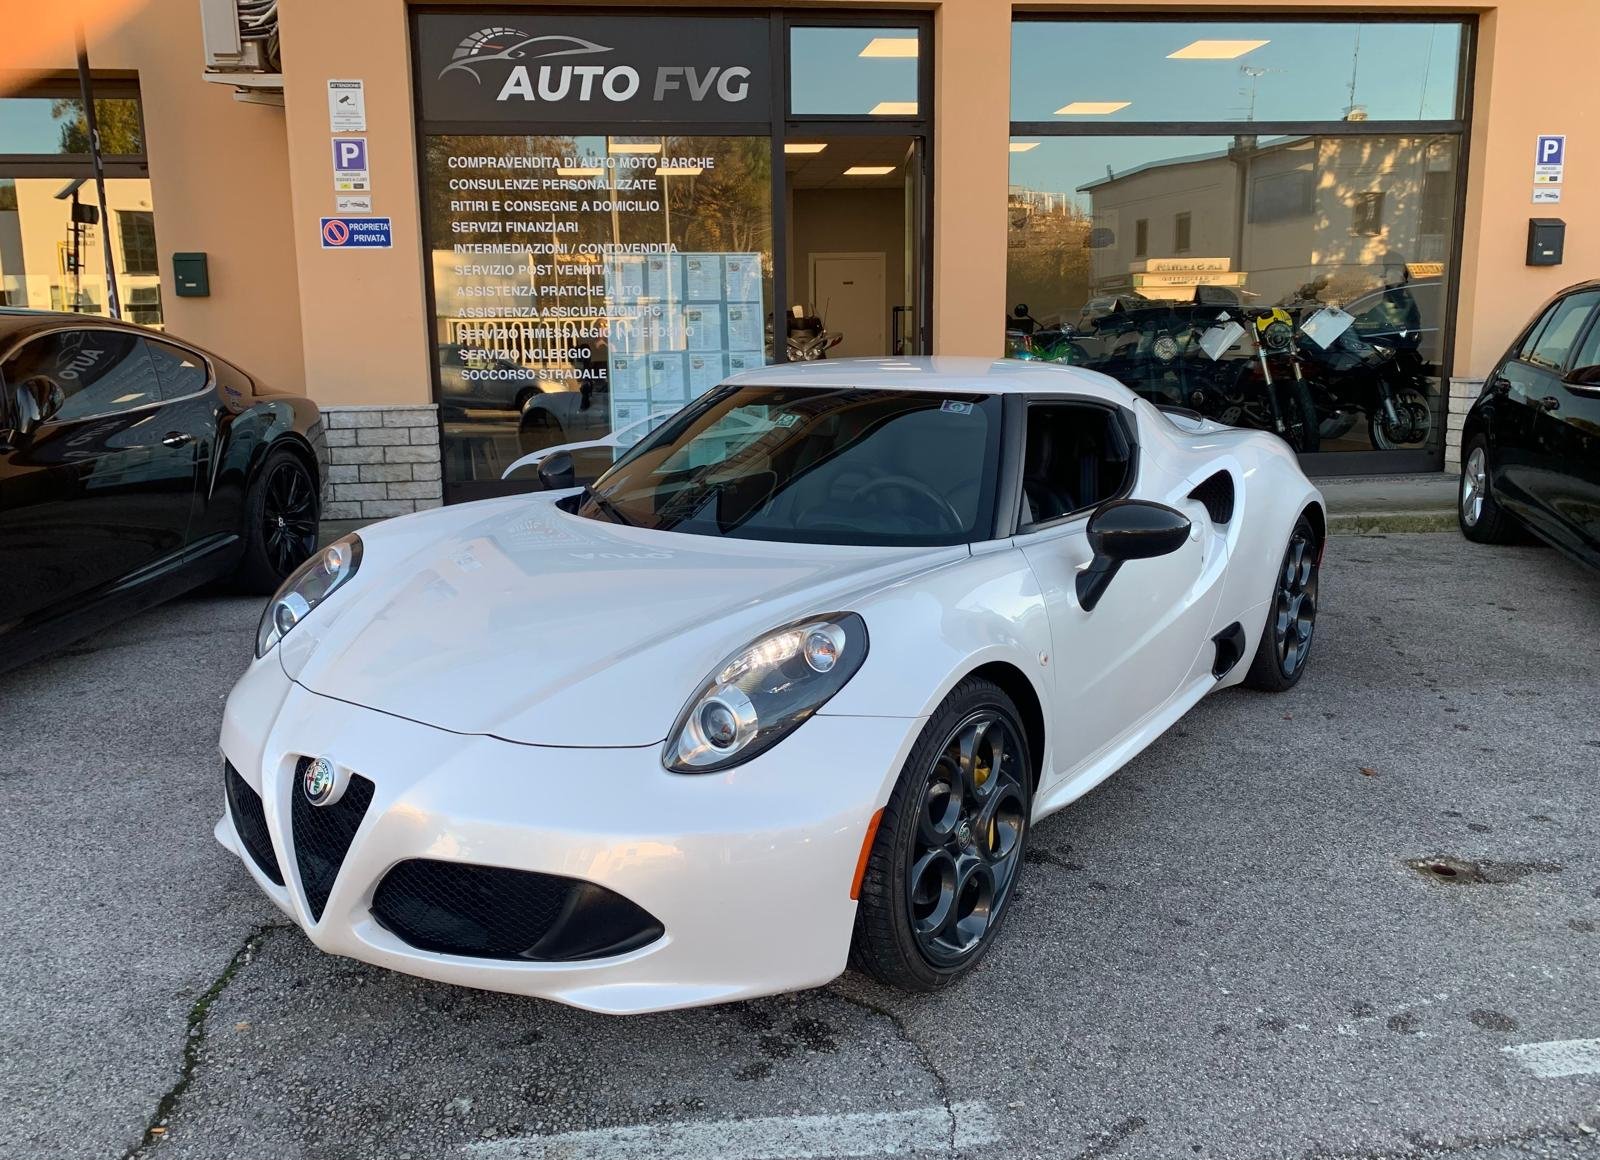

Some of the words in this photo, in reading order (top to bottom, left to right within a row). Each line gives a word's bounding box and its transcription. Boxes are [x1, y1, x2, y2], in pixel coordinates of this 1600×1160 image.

[497, 65, 640, 101] AUTO
[653, 66, 752, 102] FVG
[341, 142, 359, 168] P
[1542, 139, 1559, 162] P
[448, 156, 560, 168] COMPRAVENDITA
[564, 157, 577, 168] DI
[581, 157, 616, 169] AUTO
[620, 157, 657, 169] MOTO
[661, 157, 715, 169] BARCHE
[449, 179, 539, 190] CONSULENZE
[543, 179, 657, 190] PERSONALIZZATE
[451, 200, 489, 212] RITIRI
[492, 200, 500, 212] E
[504, 200, 578, 212] CONSEGNE
[581, 200, 590, 212] A
[593, 200, 660, 212] DOMICILIO
[451, 221, 502, 233] SERVIZI
[506, 221, 578, 233] FINANZIARI
[353, 234, 386, 242] PRIVATA
[454, 243, 568, 254] INTERMEDIAZIONI
[578, 243, 678, 254] CONTOVENDITA
[455, 264, 514, 275] SERVIZIO
[518, 264, 553, 275] POST
[557, 264, 611, 275] VENDITA
[457, 286, 538, 297] ASSISTENZA
[541, 285, 604, 296] PRATICHE
[608, 285, 642, 296] AUTO
[459, 306, 540, 318] ASSISTENZA
[459, 328, 519, 340] SERVIZIO
[523, 327, 612, 339] RIMESSAGGIO
[460, 348, 520, 360] SERVIZIO
[523, 347, 591, 359] NOLEGGIO
[461, 369, 536, 381] SOCCORSO
[539, 368, 607, 380] STRADALE
